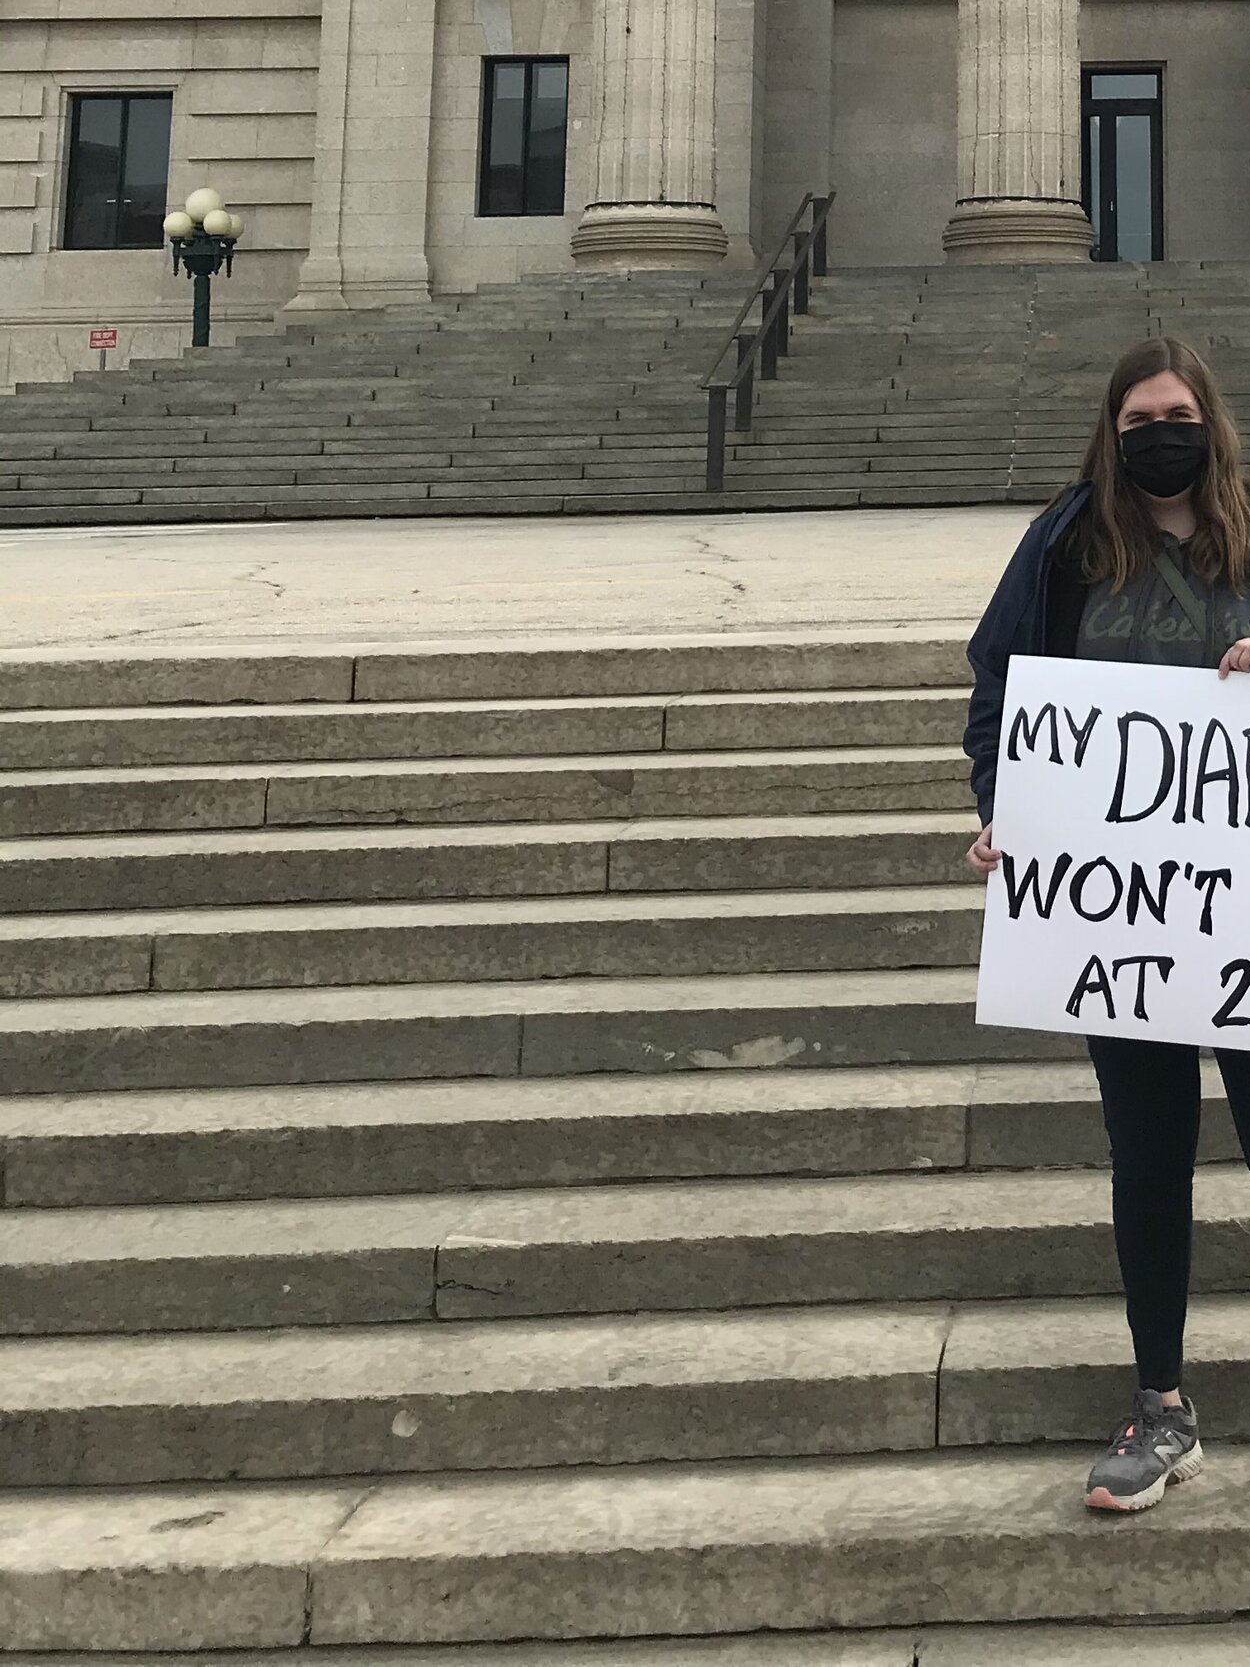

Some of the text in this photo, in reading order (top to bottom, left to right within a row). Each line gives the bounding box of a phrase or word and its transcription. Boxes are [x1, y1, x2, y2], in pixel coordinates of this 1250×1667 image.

[1007, 702, 1102, 768] MY
[1001, 851, 1231, 936] WON'T
[1065, 954, 1175, 1022] AT
